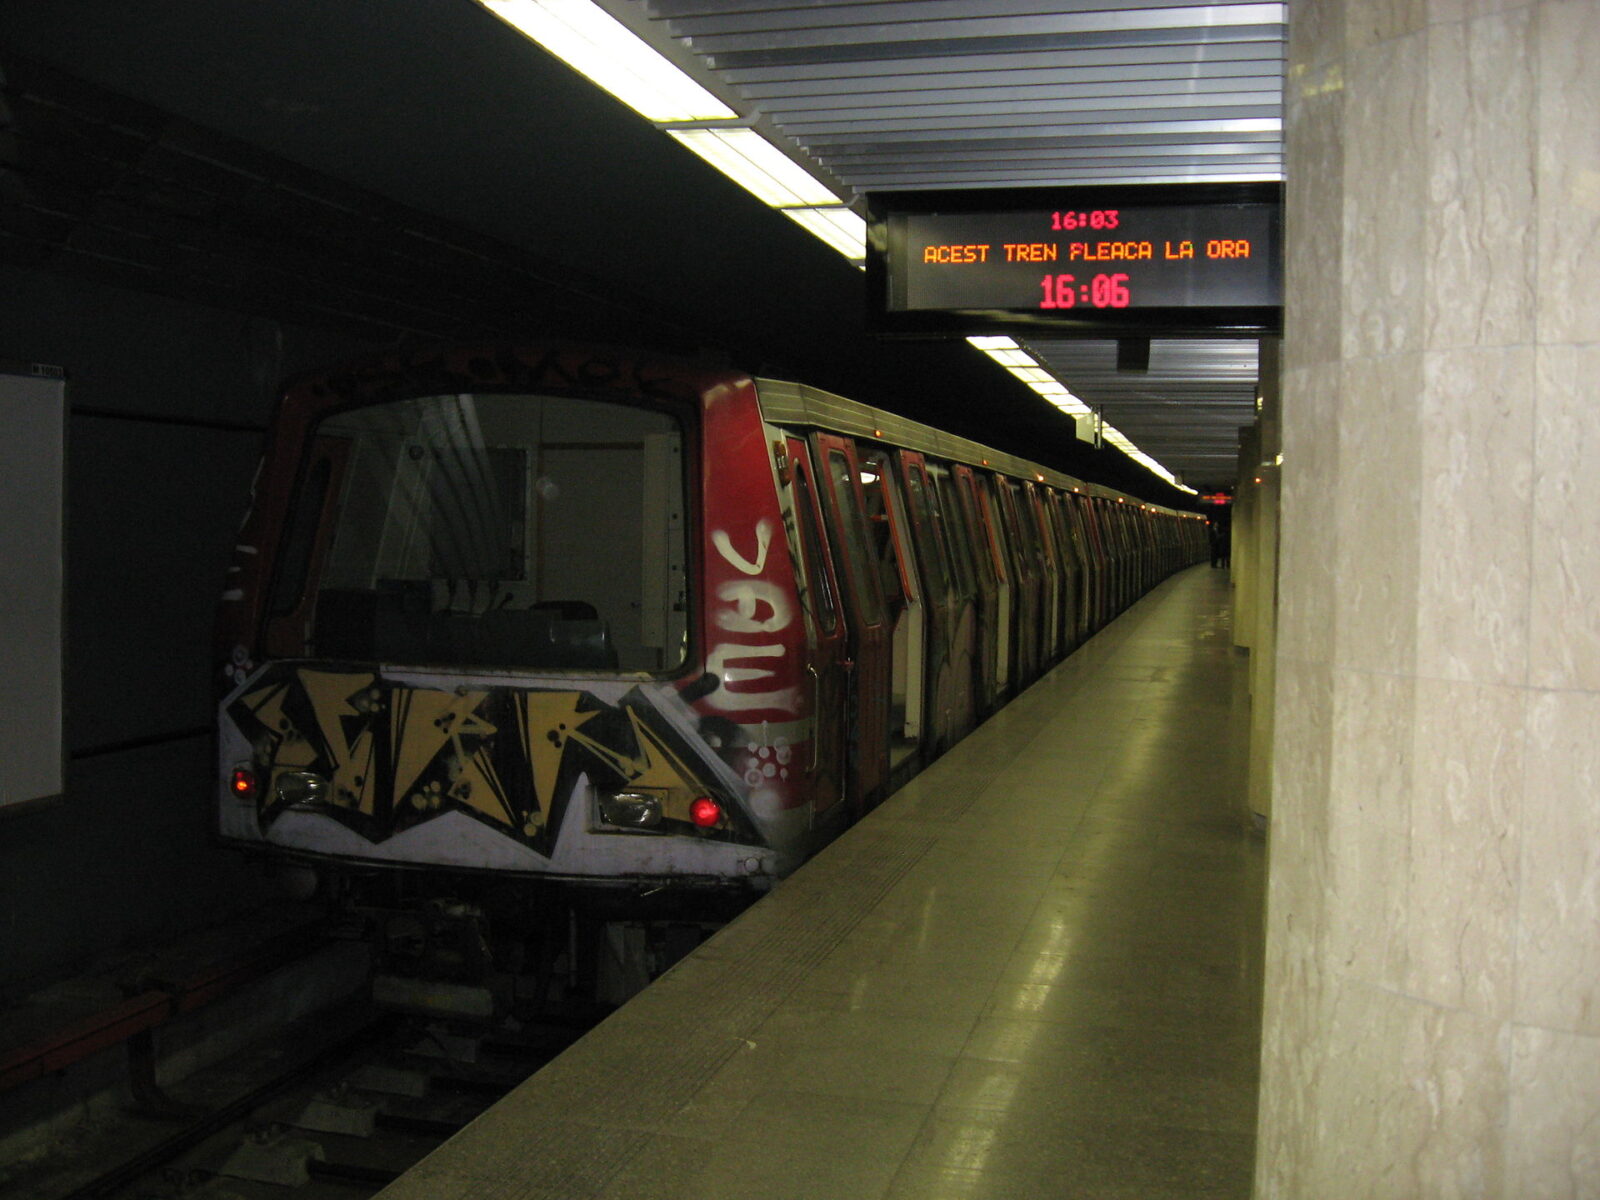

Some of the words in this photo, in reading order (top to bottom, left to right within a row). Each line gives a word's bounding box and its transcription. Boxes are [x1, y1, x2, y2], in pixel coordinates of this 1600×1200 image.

[1051, 210, 1119, 230] 16:03
[923, 244, 990, 264] ACEST
[1003, 243, 1057, 262] TREN
[1069, 241, 1152, 262] PLEACA
[1164, 240, 1194, 260] LA
[1206, 239, 1250, 259] ORA
[1039, 274, 1130, 309] 16:06
